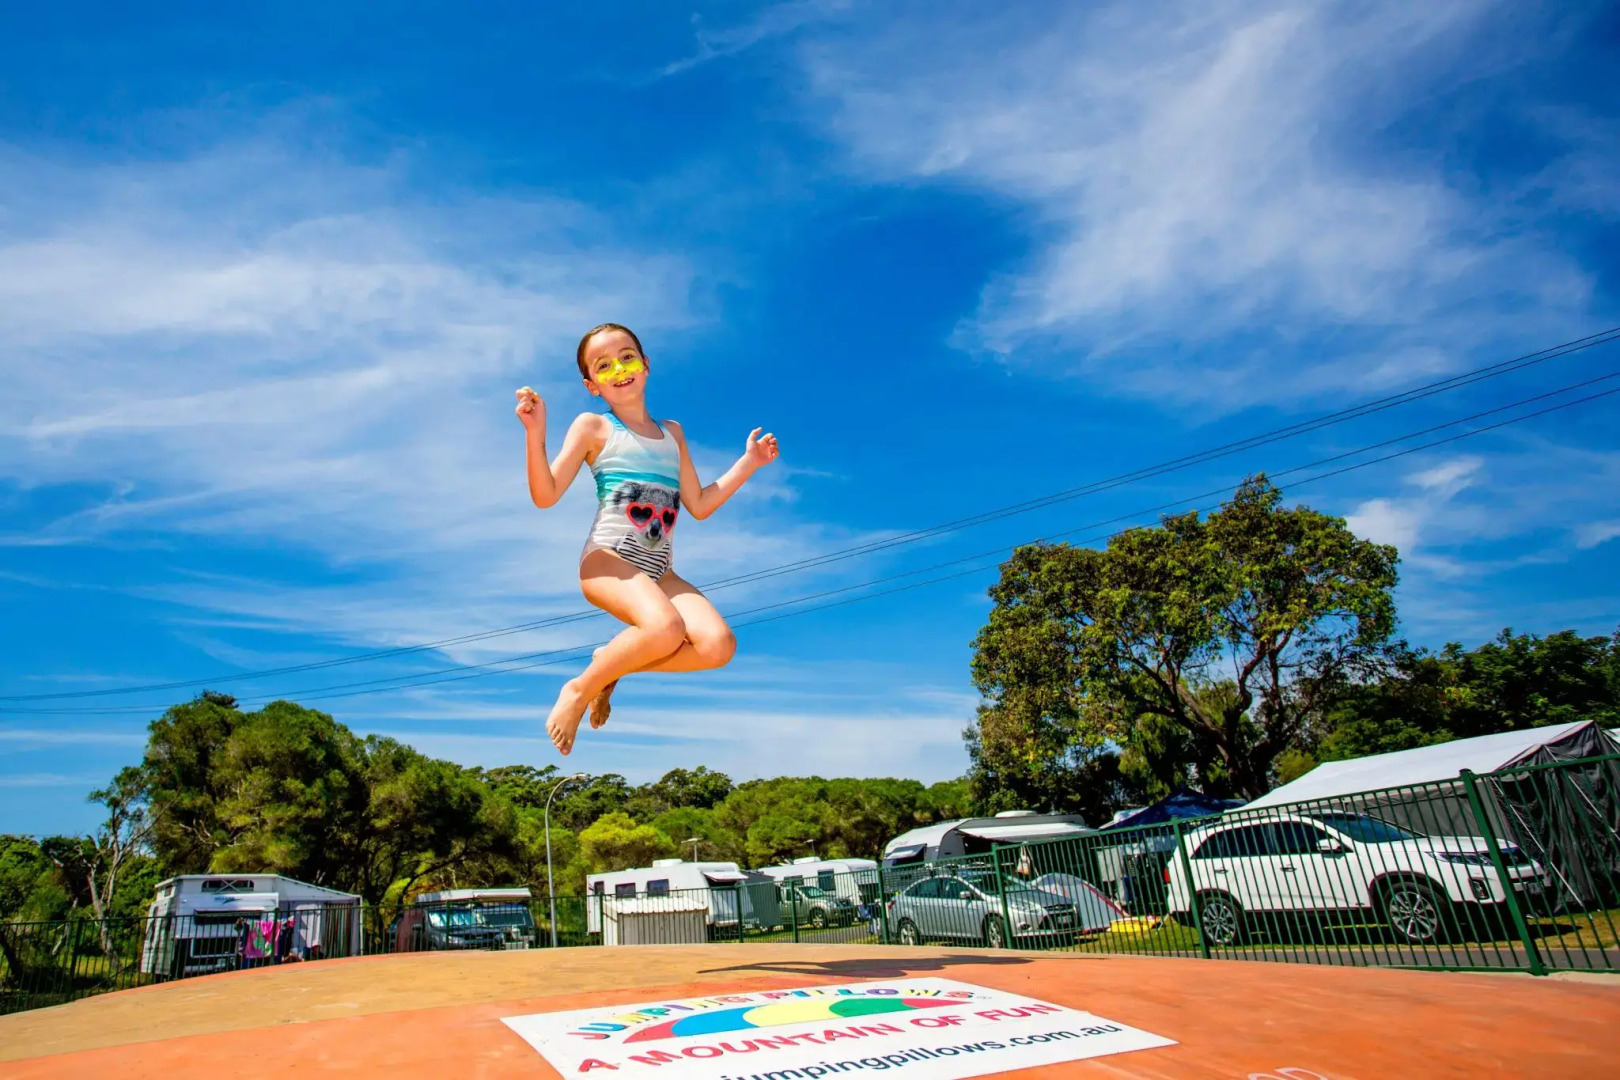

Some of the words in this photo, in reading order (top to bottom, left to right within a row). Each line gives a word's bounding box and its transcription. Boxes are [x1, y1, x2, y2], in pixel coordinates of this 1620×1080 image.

[567, 995, 752, 1040] JUMPING
[758, 988, 974, 1000] PILLOWS
[577, 1058, 620, 1072] A
[628, 1023, 905, 1066] MOUNTAIN
[909, 1015, 966, 1028] OF
[974, 1003, 1064, 1021] FUN
